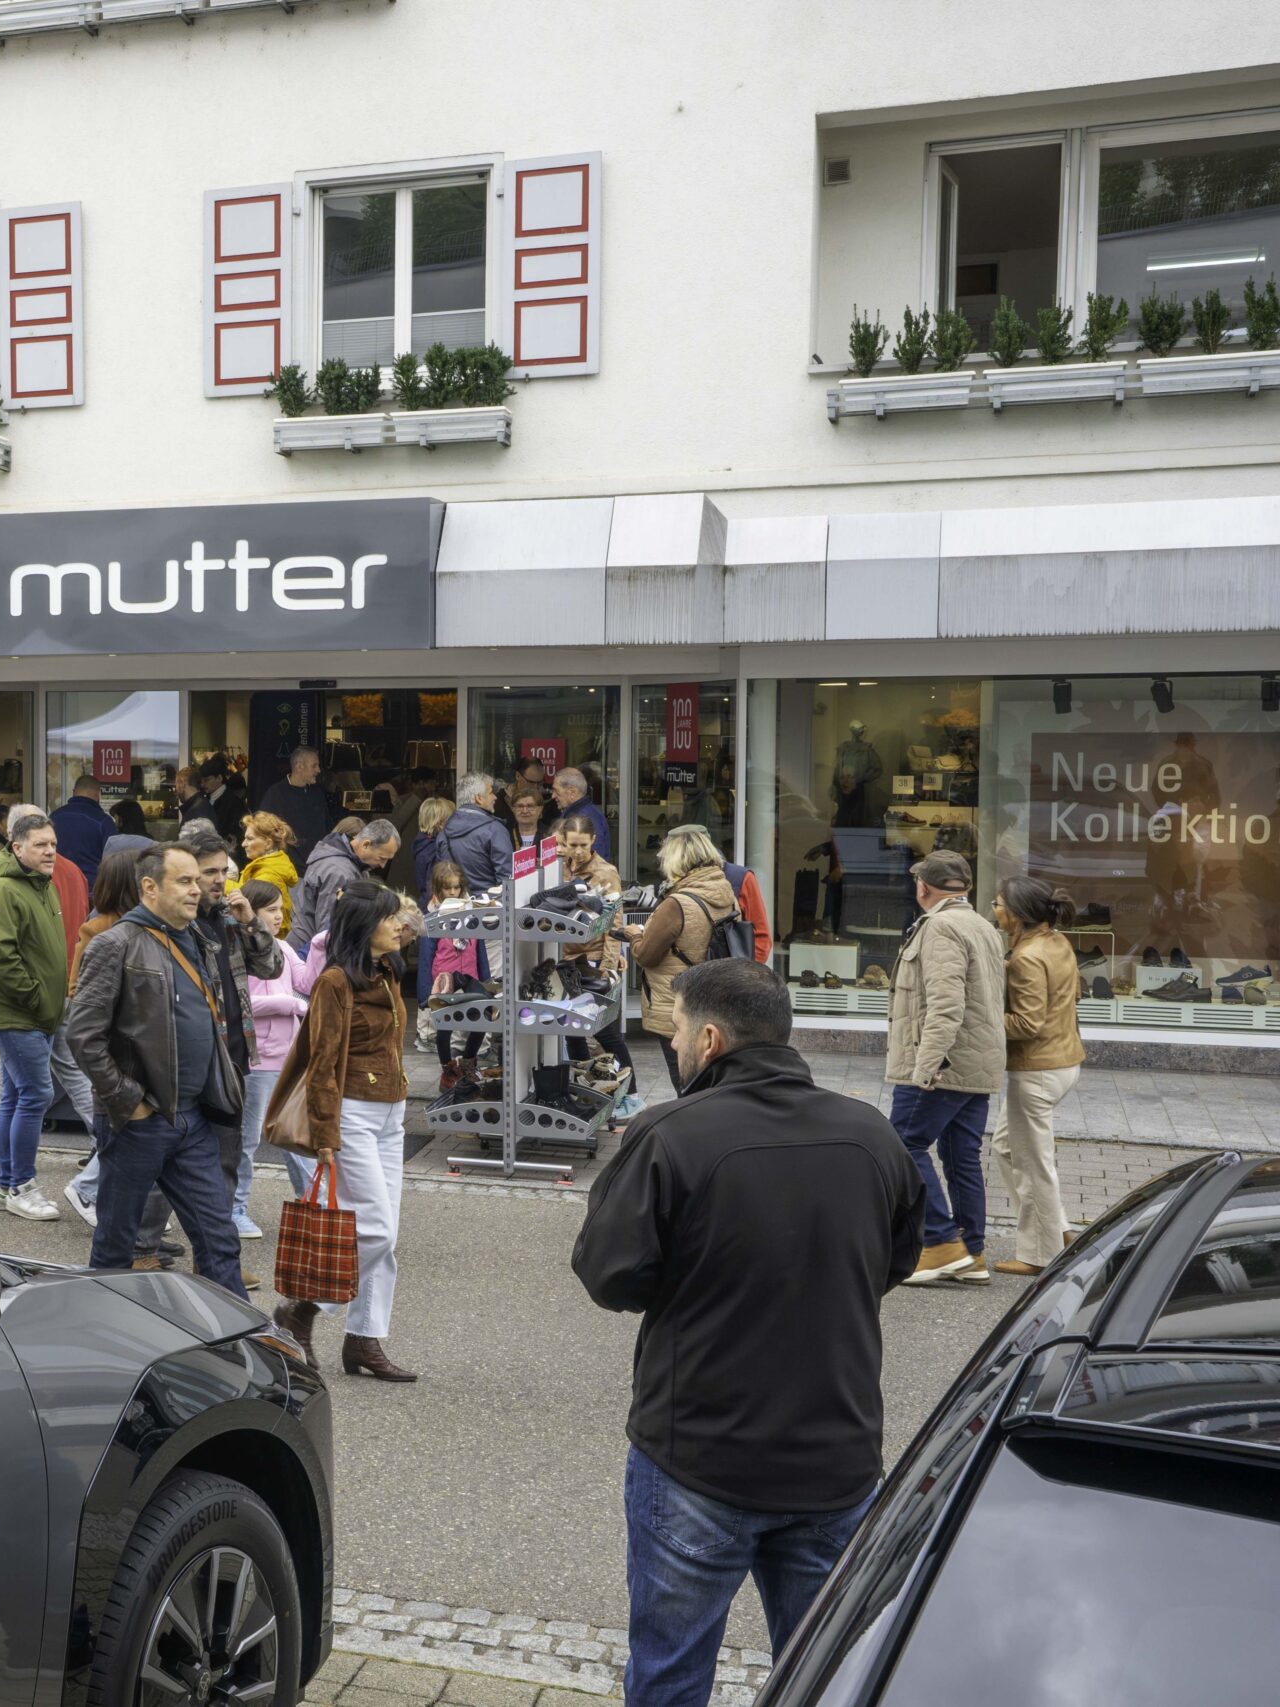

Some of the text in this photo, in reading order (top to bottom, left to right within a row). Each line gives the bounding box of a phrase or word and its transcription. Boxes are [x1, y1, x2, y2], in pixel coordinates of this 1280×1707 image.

[10, 539, 388, 616] mutter
[672, 698, 692, 749] 100
[101, 748, 124, 776] 100
[666, 769, 696, 783] mutter
[1051, 751, 1183, 793] Neue
[1050, 802, 1280, 844] Kollektio
